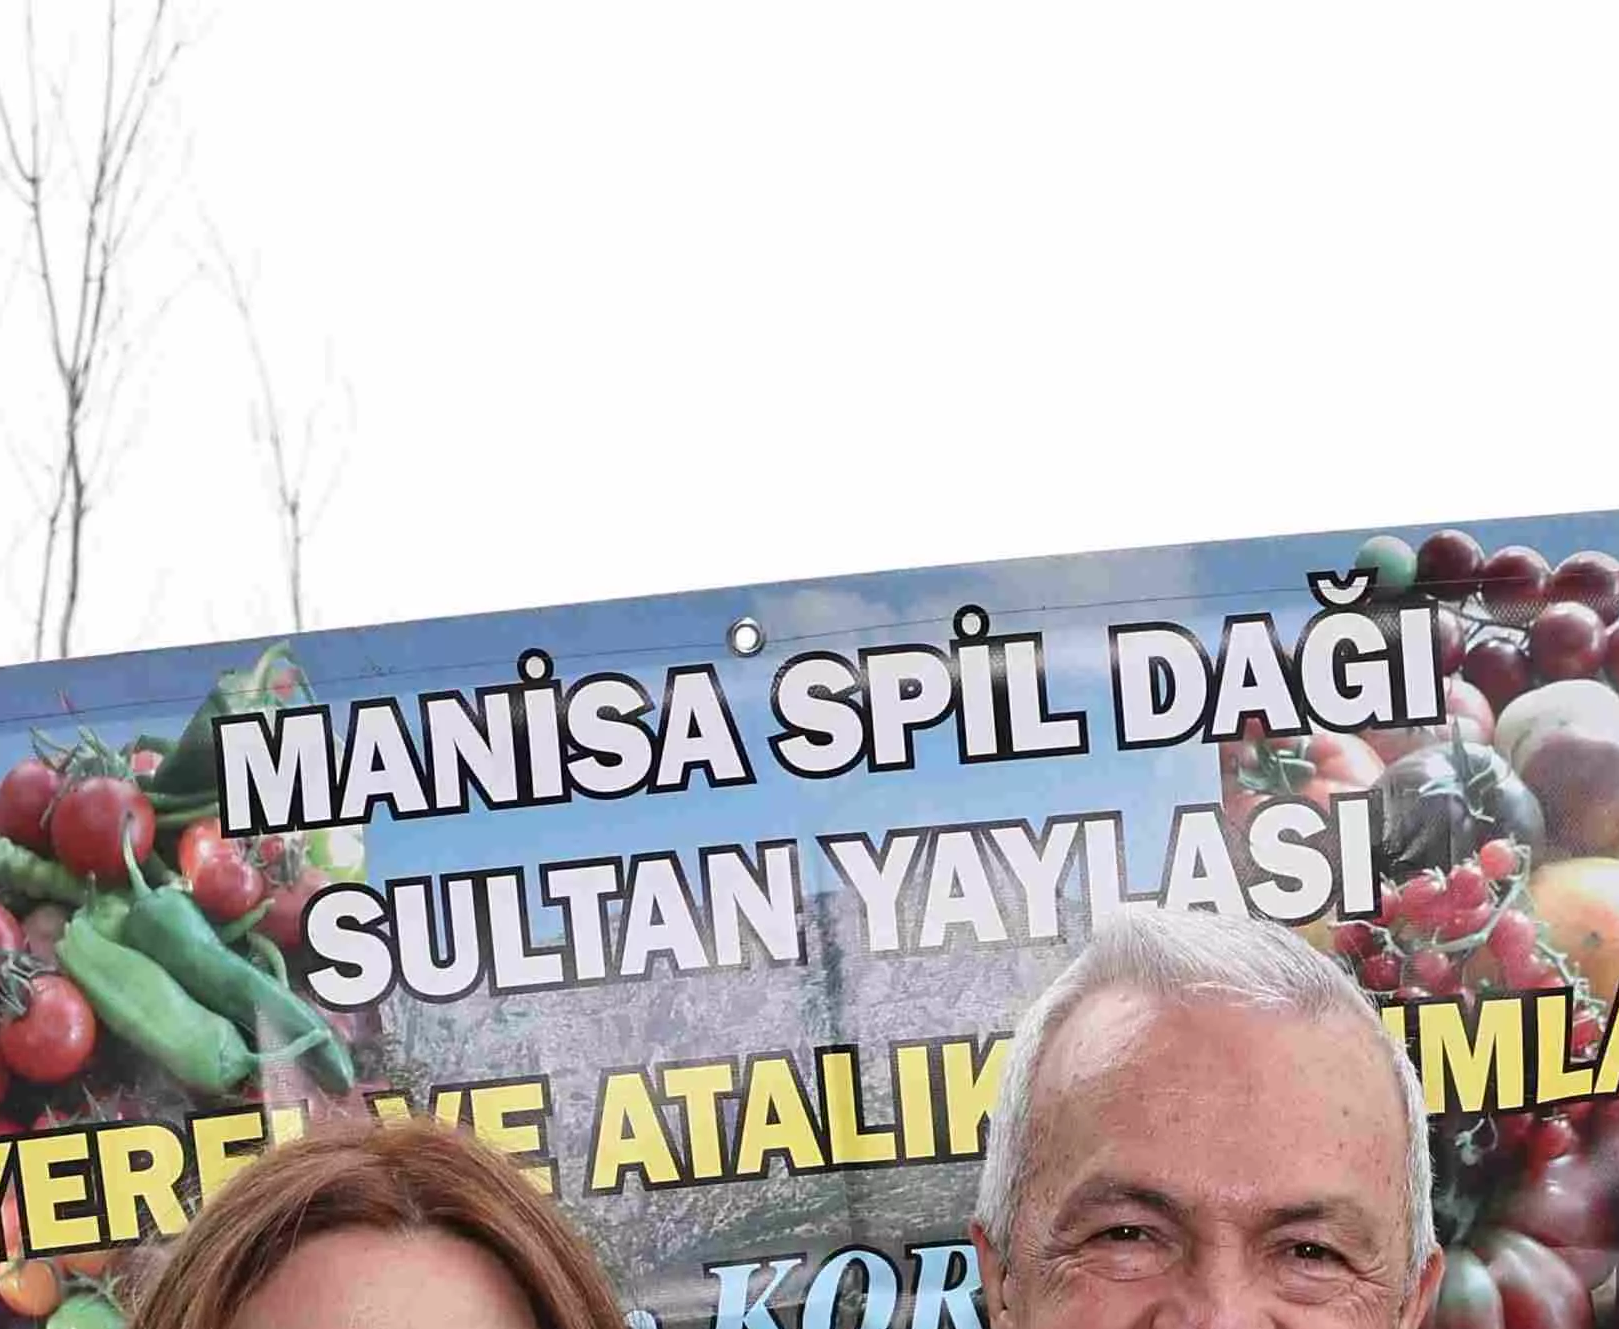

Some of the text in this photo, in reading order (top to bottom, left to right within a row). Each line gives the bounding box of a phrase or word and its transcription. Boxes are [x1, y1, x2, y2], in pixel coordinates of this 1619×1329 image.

[211, 569, 1446, 838] MANİSA SPİL DAĞI
[302, 789, 1381, 1012] SULTAN YAYLASI
[584, 1031, 1014, 1197] ATALIK
